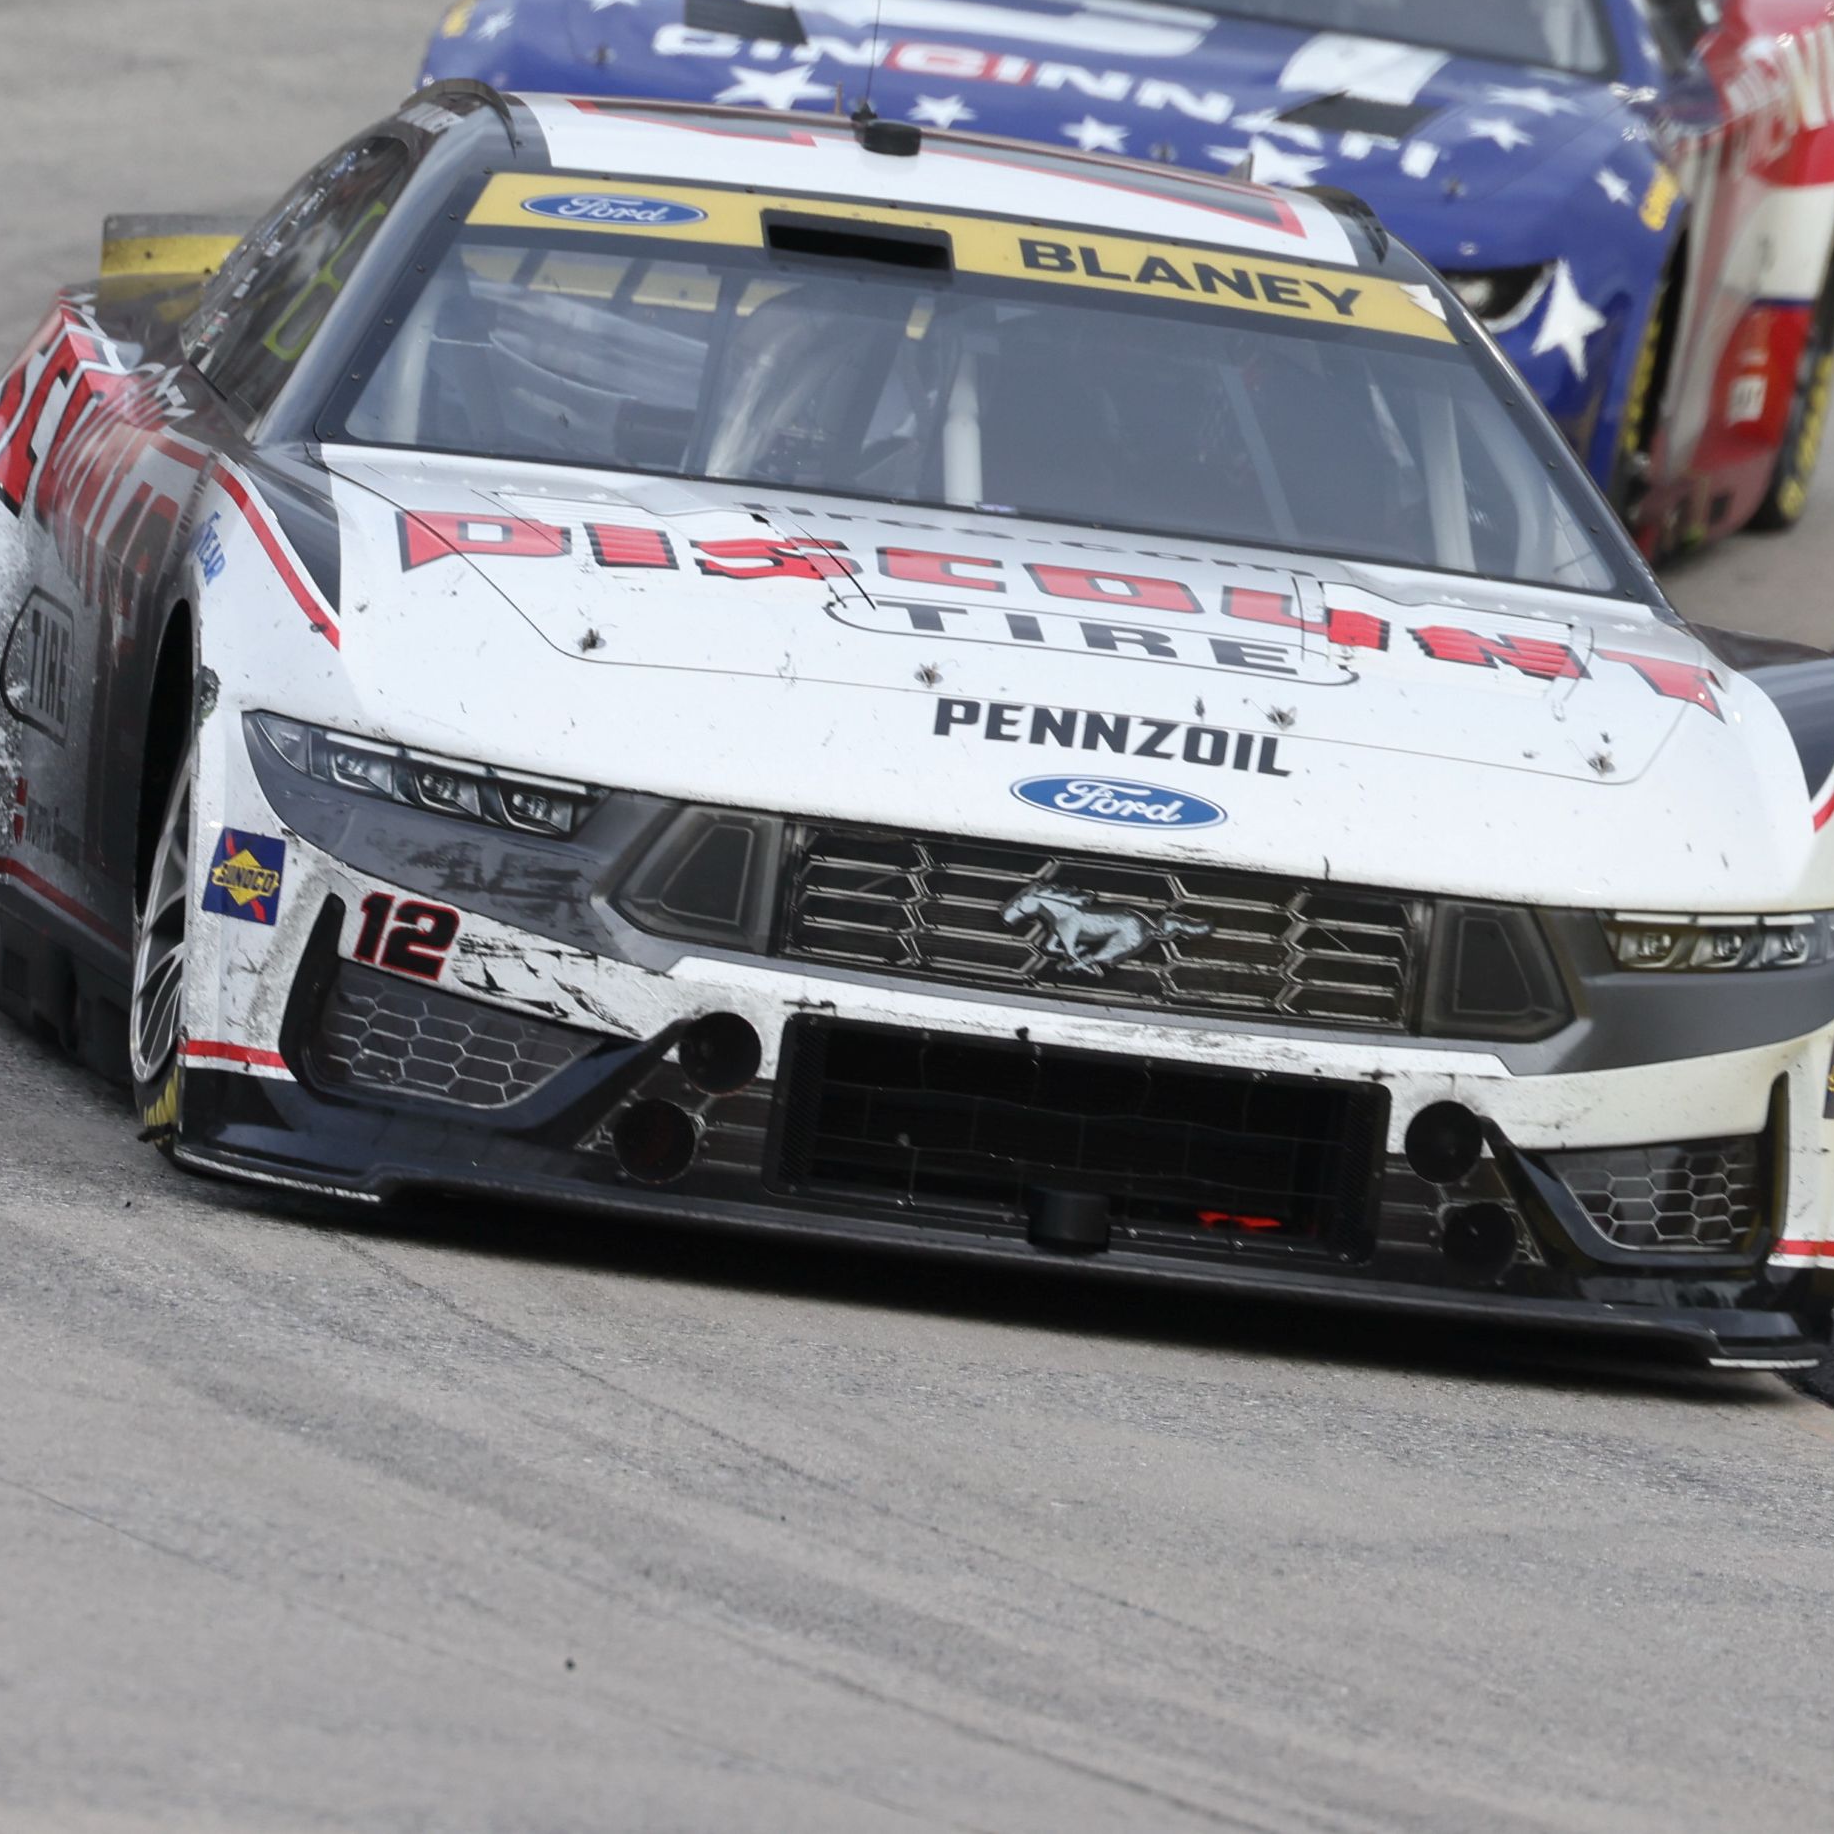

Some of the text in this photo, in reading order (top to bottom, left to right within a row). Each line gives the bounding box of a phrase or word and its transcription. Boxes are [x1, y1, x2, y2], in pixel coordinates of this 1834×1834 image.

[558, 196, 669, 222] Ford
[1019, 238, 1363, 318] BLANEY
[397, 509, 1728, 725] DISCOUNT
[873, 600, 1298, 676] TIRE
[933, 697, 1294, 778] PENNZOIL
[1054, 780, 1184, 823] Ford
[214, 863, 277, 894] SUNOCO
[352, 892, 461, 981] 12
